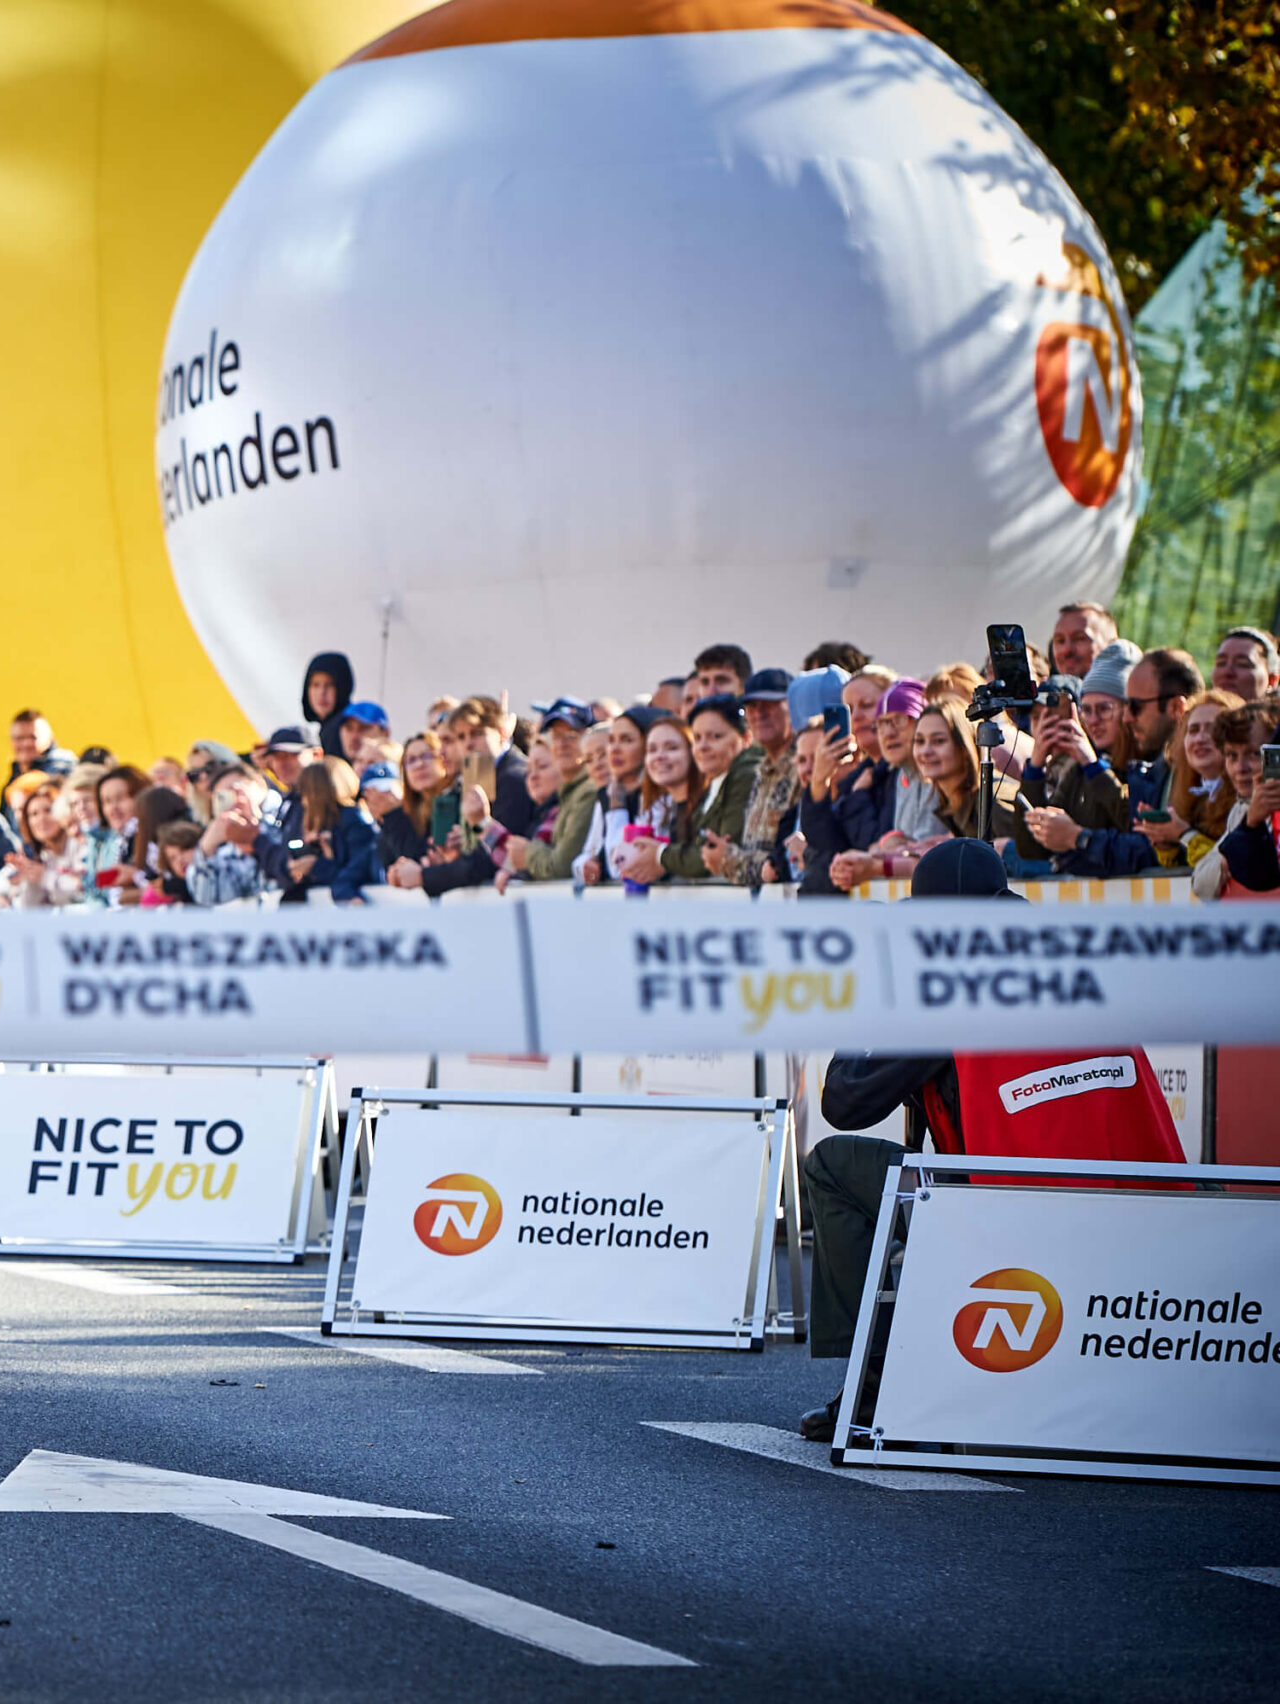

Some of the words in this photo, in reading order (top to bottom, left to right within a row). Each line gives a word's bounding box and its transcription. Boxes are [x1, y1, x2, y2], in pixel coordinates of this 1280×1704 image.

[61, 932, 448, 968] WARSZAWSKA
[635, 927, 765, 967] NICE
[778, 927, 855, 967] TO
[914, 924, 1280, 959] WARSZAWSKA
[63, 977, 252, 1017] DYCHA
[638, 972, 728, 1014] FIT
[739, 969, 856, 1035] you
[919, 969, 1105, 1009] DYCHA
[33, 1117, 157, 1154] NICE
[174, 1119, 244, 1156] TO
[28, 1160, 119, 1196] FIT
[119, 1161, 238, 1217] you
[521, 1190, 664, 1218] nationale
[517, 1221, 710, 1249] nederlanden
[1086, 1289, 1263, 1324] nationale
